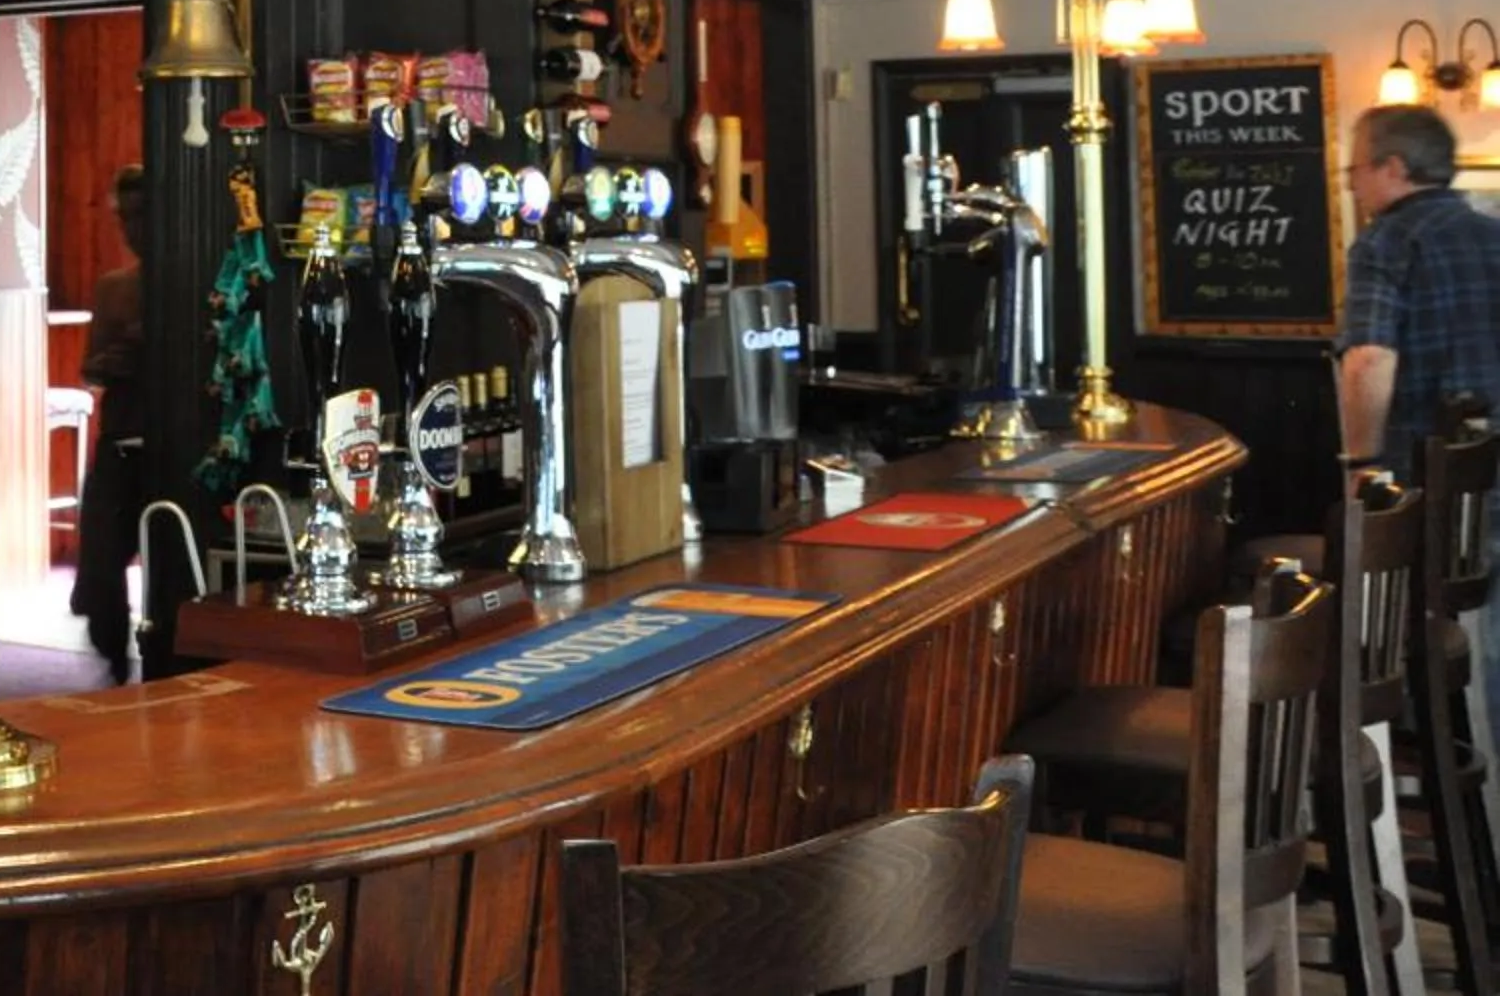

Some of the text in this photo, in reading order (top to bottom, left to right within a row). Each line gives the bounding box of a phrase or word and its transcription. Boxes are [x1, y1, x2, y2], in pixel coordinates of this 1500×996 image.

[1164, 85, 1311, 128] SPORT
[1171, 125, 1304, 145] THIS WEEK
[1181, 184, 1280, 215] QUIZ
[1172, 216, 1295, 248] NIGHT
[461, 610, 690, 684] FOSTER'S
